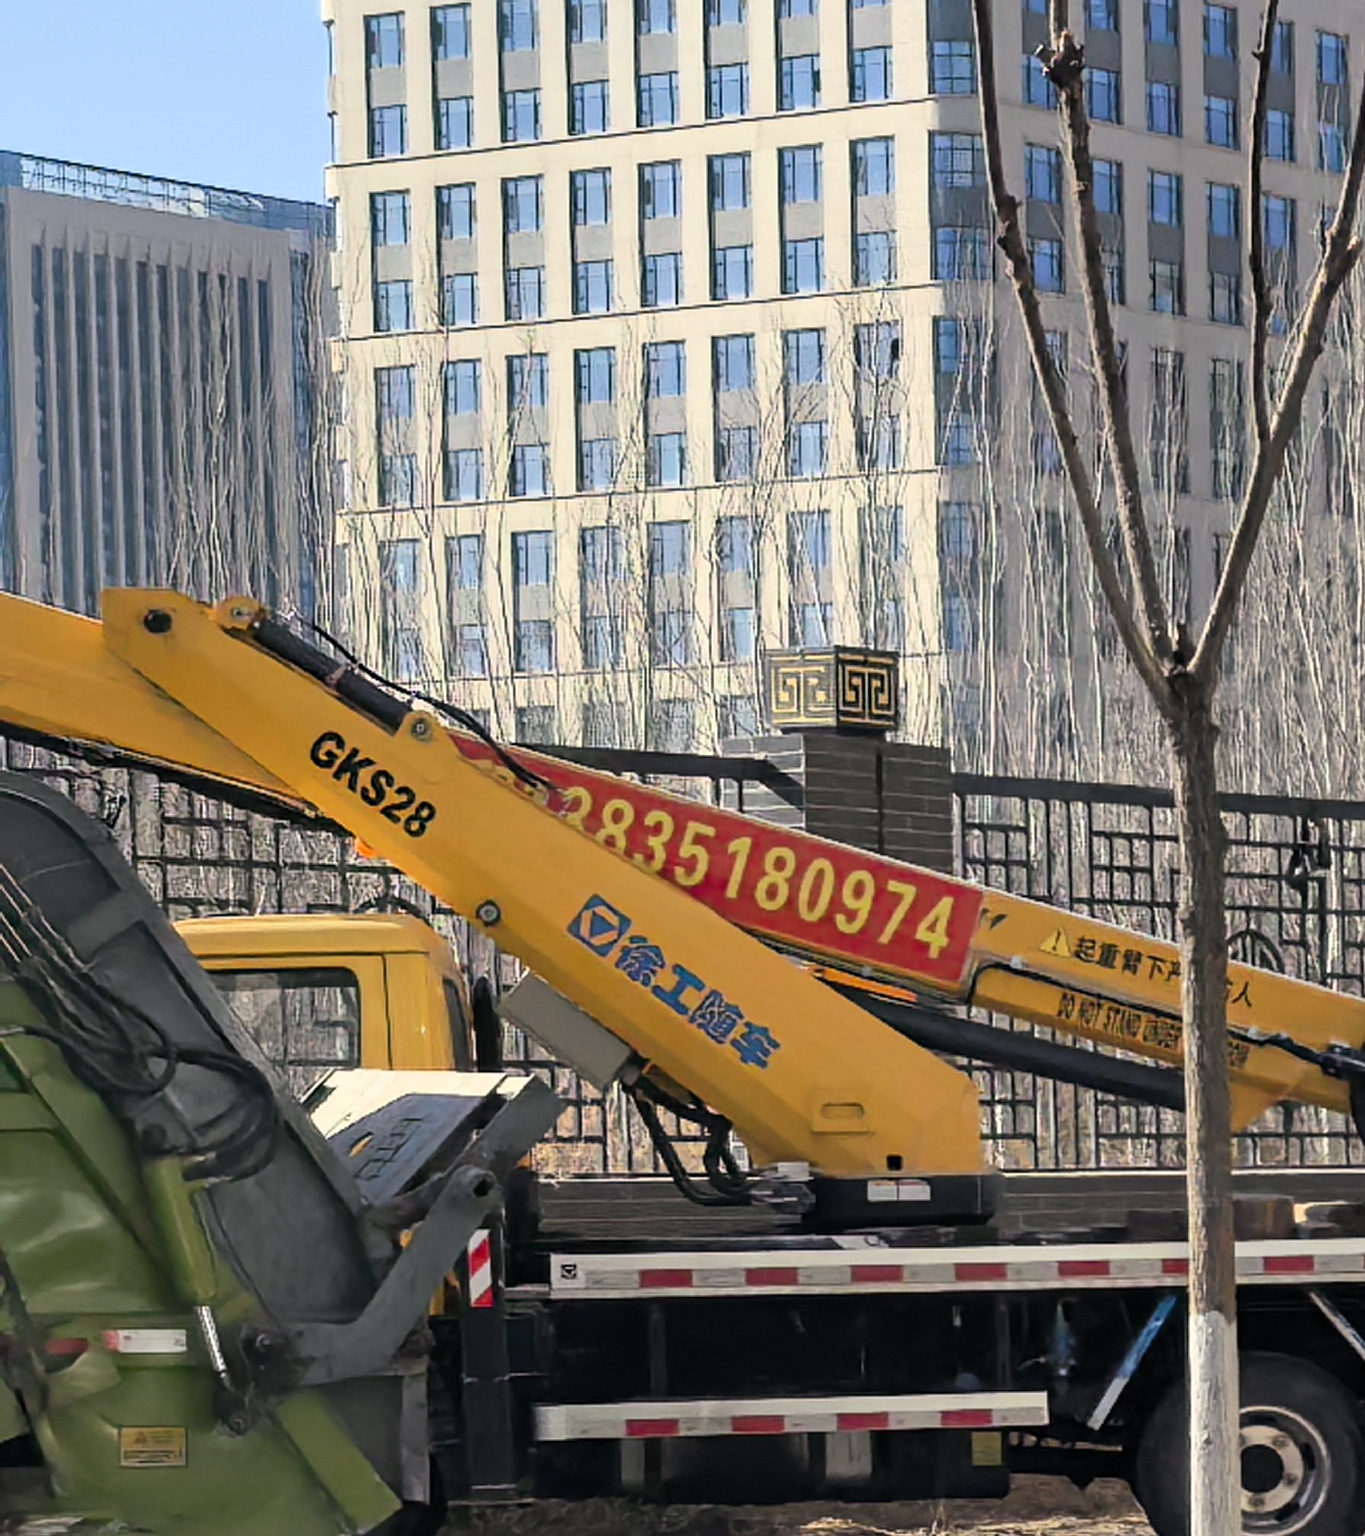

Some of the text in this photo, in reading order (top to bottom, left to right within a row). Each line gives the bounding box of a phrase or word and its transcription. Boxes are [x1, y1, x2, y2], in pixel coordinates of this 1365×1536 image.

[310, 731, 436, 837] GKS28
[533, 777, 955, 960] 3835180974
[615, 935, 781, 1069] 徐工随车
